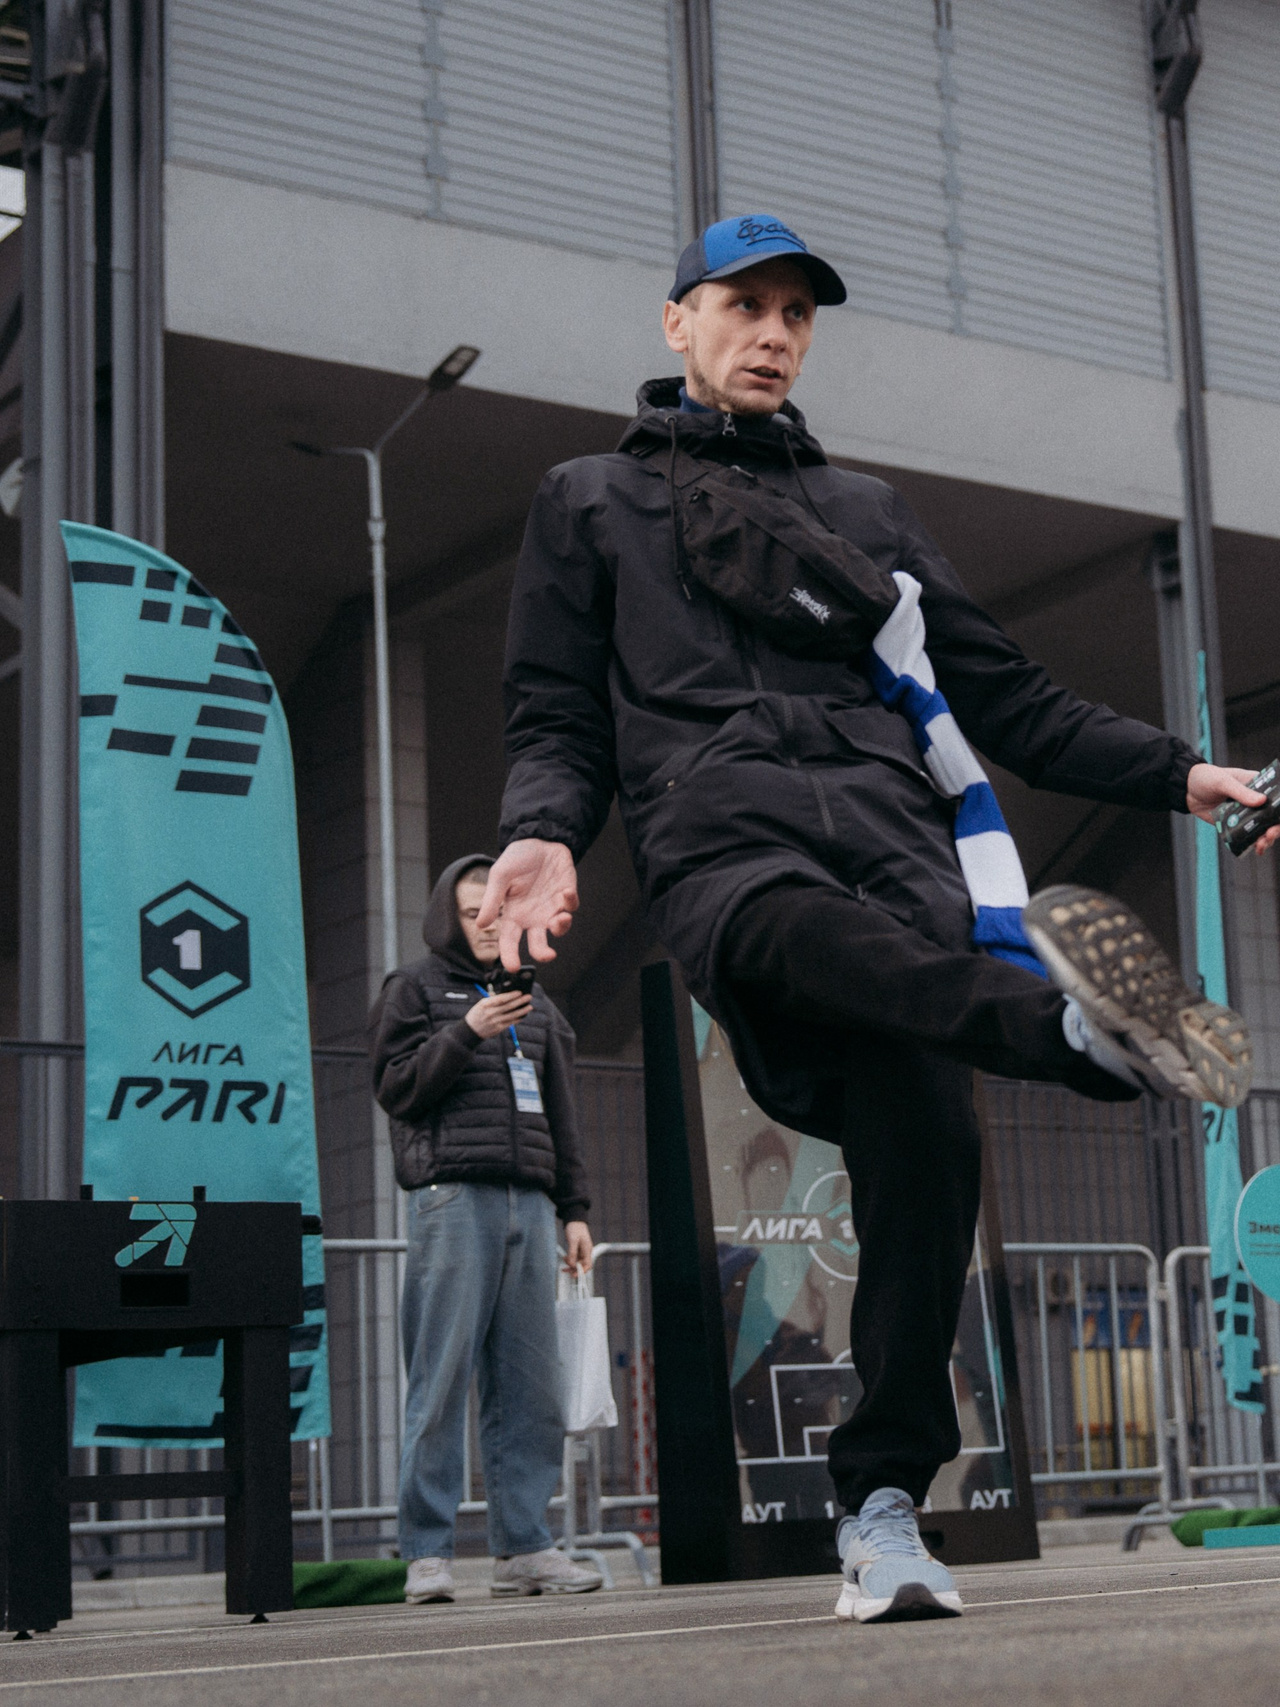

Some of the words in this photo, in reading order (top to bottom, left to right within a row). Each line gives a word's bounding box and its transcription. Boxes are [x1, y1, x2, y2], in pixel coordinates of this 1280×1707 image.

[172, 929, 202, 971] 1
[152, 1041, 245, 1066] ЛИГА
[106, 1076, 286, 1124] PARI
[740, 1217, 823, 1240] ЛИГА
[741, 1501, 786, 1524] АУТ
[824, 1500, 835, 1519] 1
[969, 1488, 1012, 1511] АУТ
